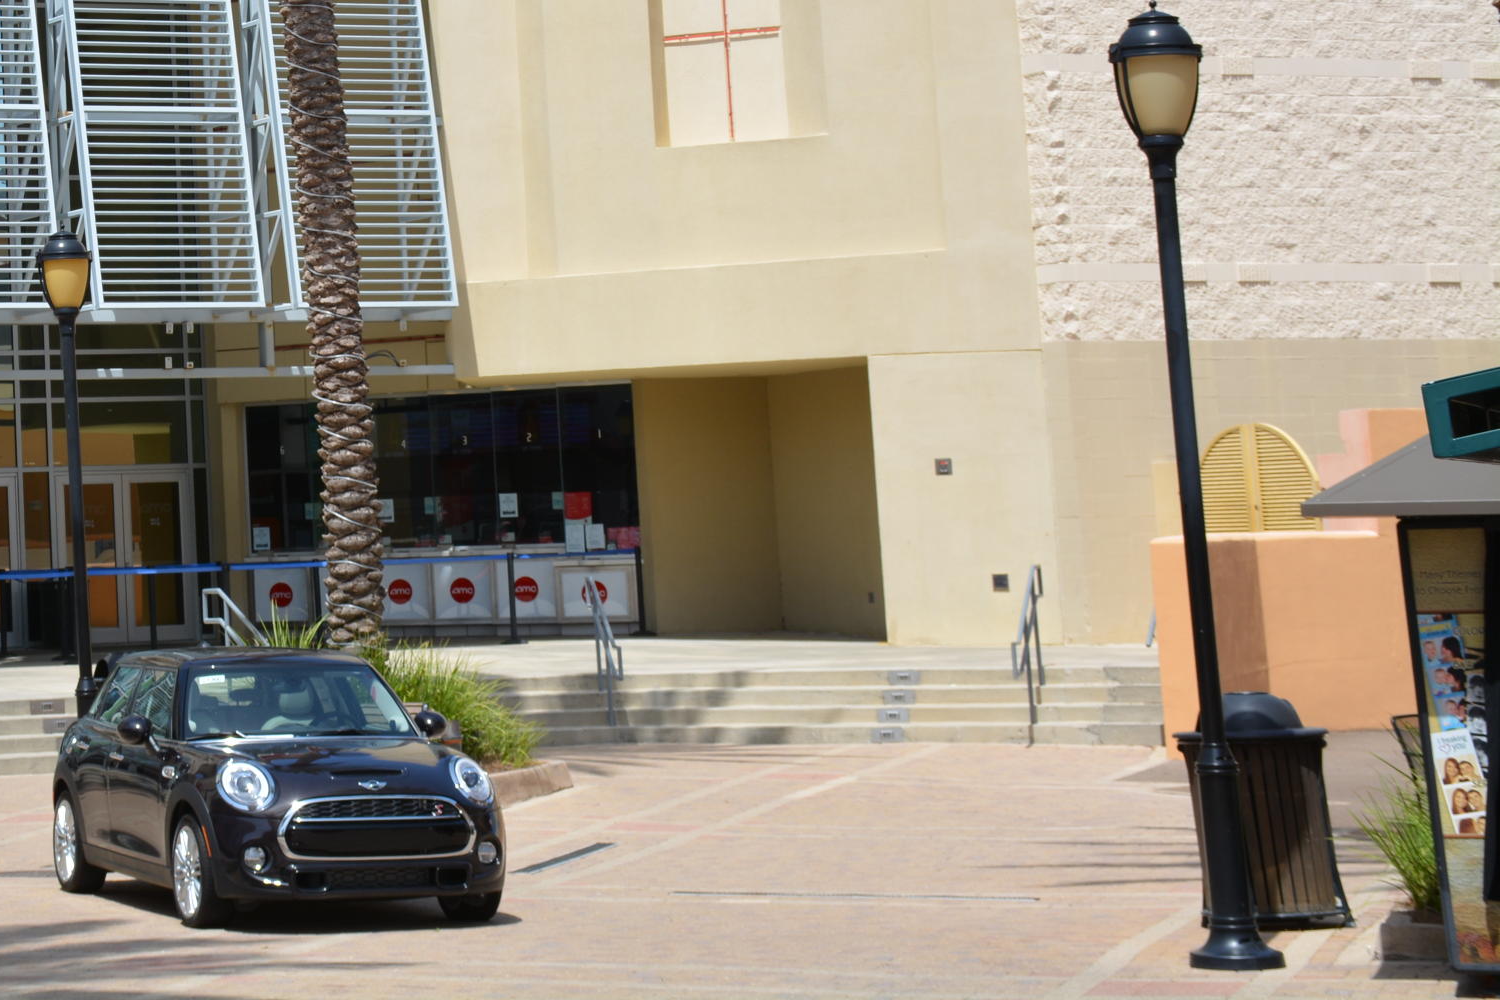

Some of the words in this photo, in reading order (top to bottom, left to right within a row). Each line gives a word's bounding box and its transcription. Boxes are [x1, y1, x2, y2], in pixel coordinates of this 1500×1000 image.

[462, 435, 468, 446] 3
[525, 432, 532, 443] 2
[390, 587, 411, 596] amc
[452, 585, 473, 594] amc
[515, 584, 536, 593] amc
[271, 591, 292, 599] amc
